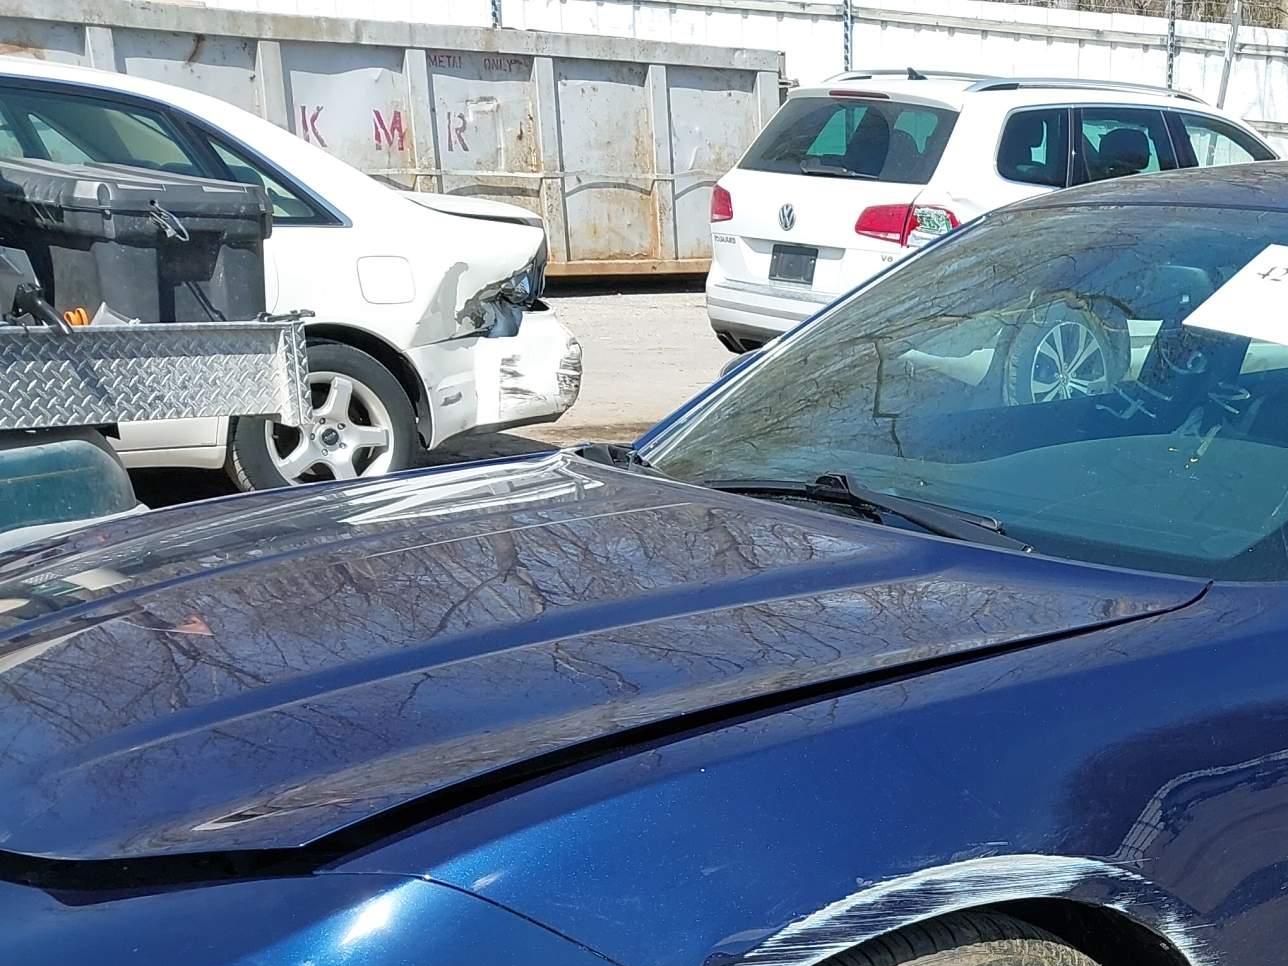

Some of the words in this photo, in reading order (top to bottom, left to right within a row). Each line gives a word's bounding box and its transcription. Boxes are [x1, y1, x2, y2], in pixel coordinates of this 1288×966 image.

[300, 105, 328, 148] K
[372, 109, 407, 151] M
[447, 111, 470, 152] R
